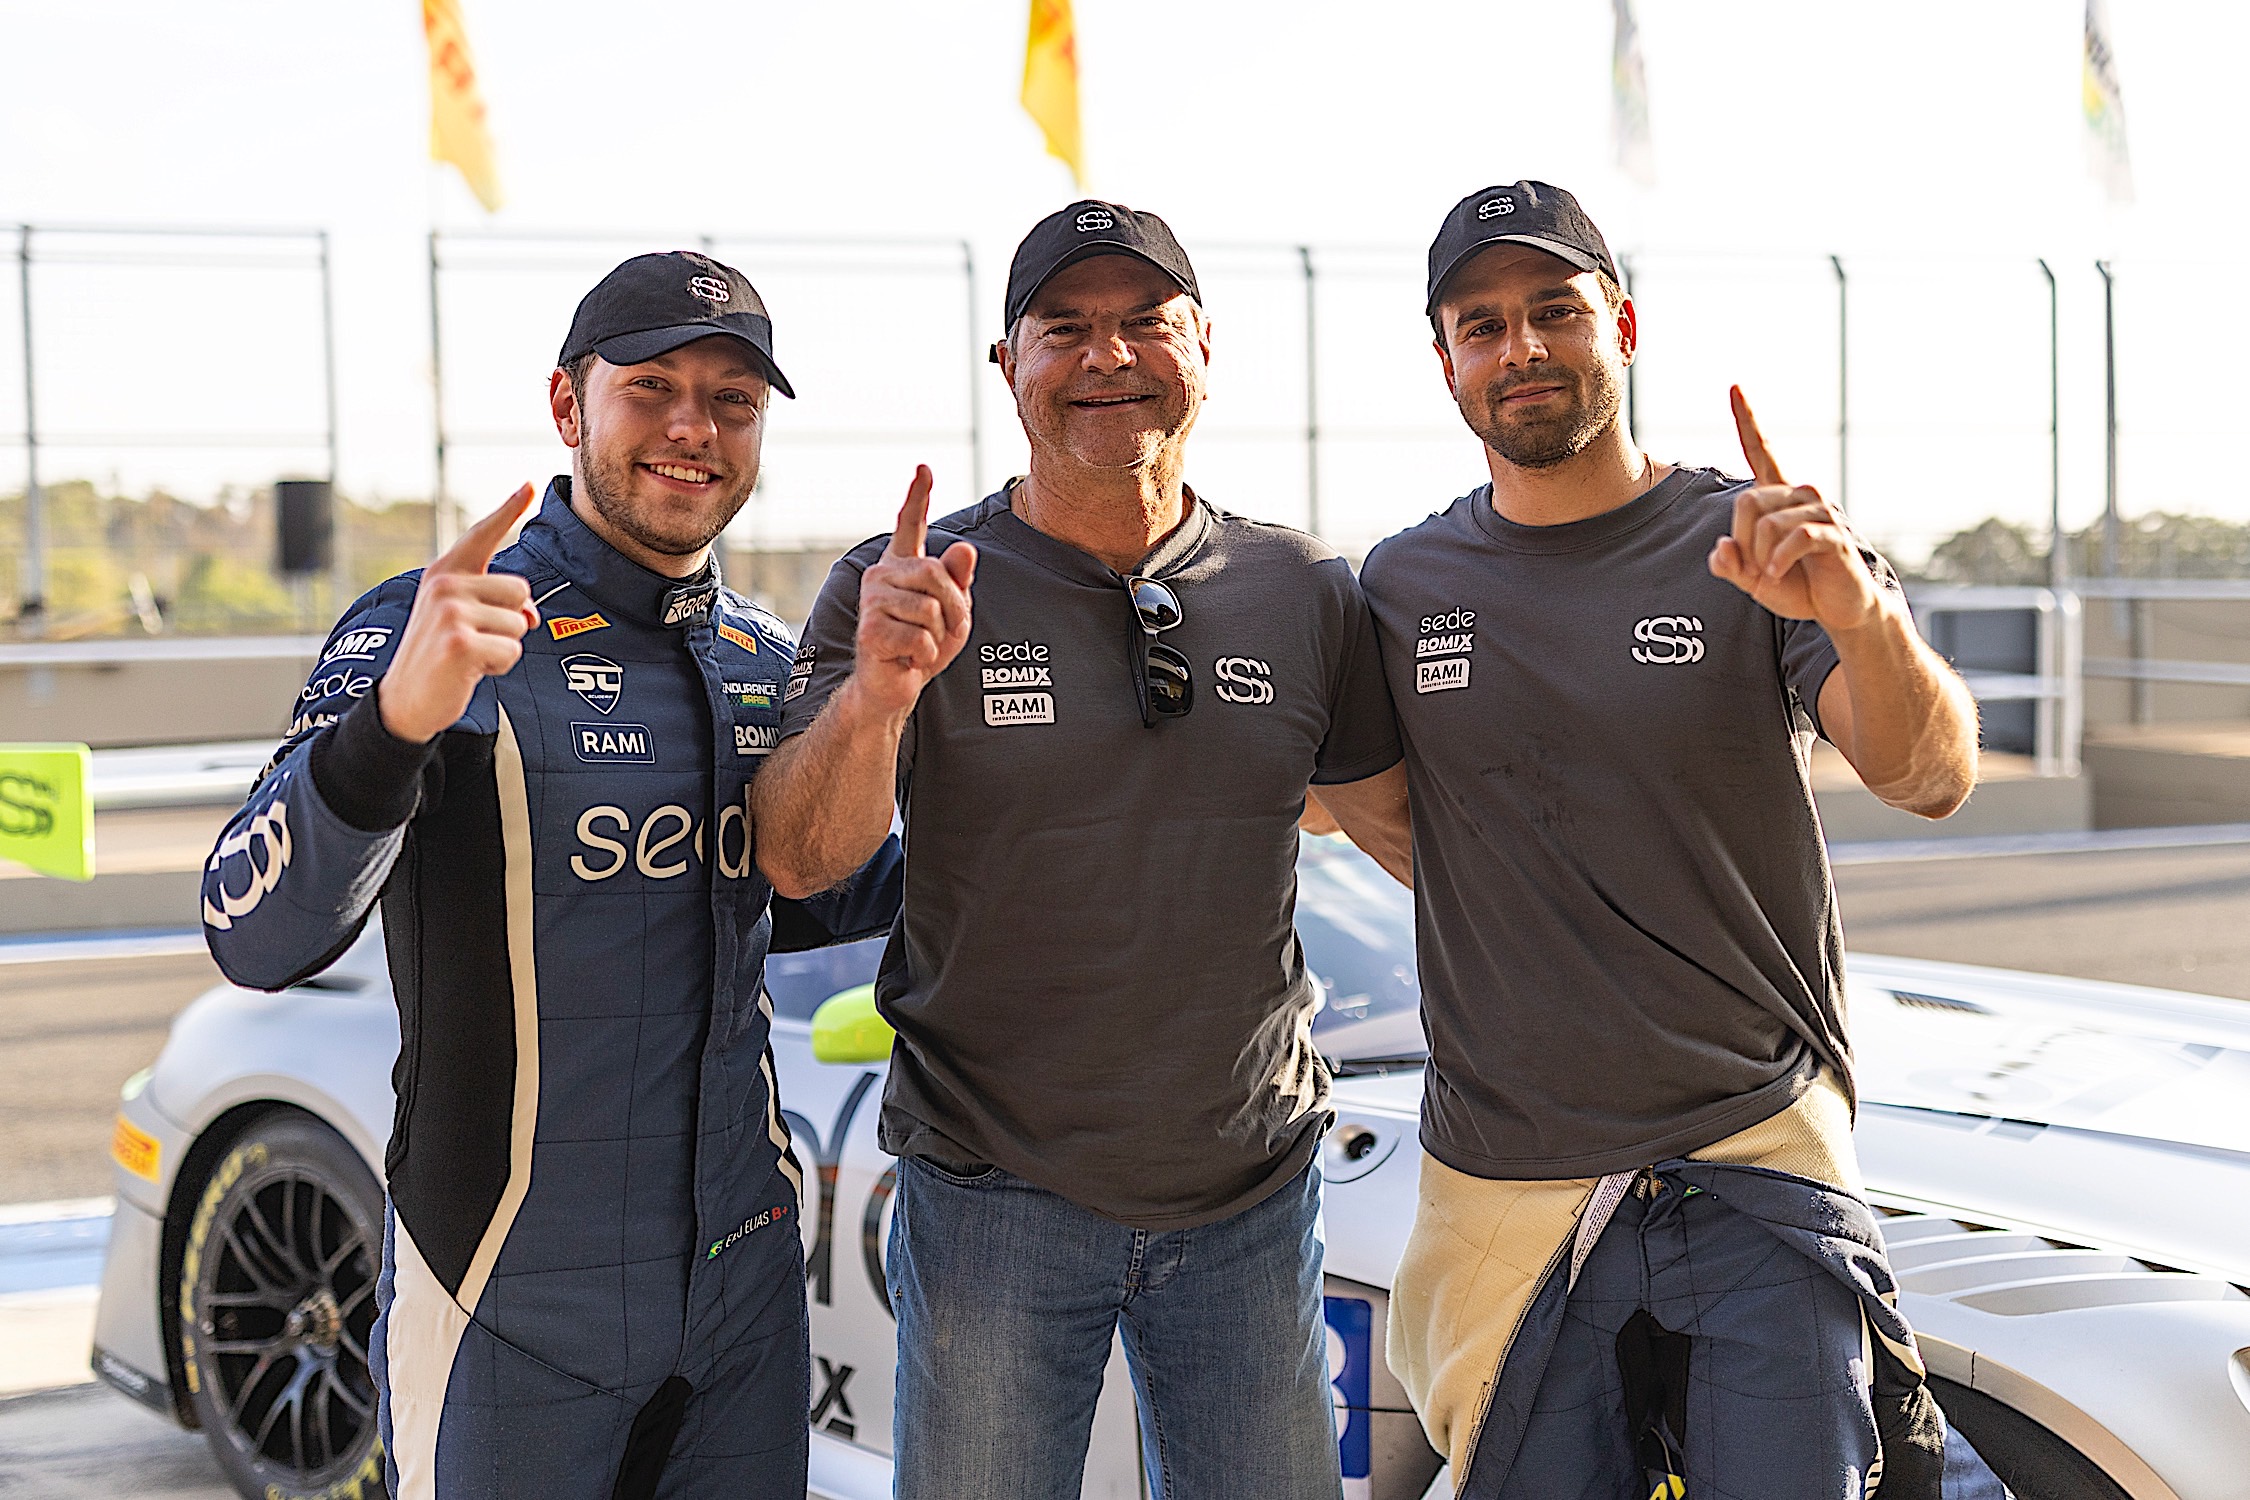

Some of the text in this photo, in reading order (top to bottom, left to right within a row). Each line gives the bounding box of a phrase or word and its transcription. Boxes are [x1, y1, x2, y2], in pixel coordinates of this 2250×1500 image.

[553, 617, 603, 636] PIRELLI
[1420, 606, 1476, 634] sede
[322, 632, 388, 663] OMP
[980, 641, 1049, 661] sede
[1416, 633, 1474, 657] BOMIX
[982, 666, 1052, 688] BOMIX
[1421, 663, 1463, 683] RAMI
[742, 694, 770, 704] BRASIL
[992, 697, 1046, 715] RAMI
[581, 731, 646, 754] RAMI
[745, 1211, 770, 1234] ELIAS
